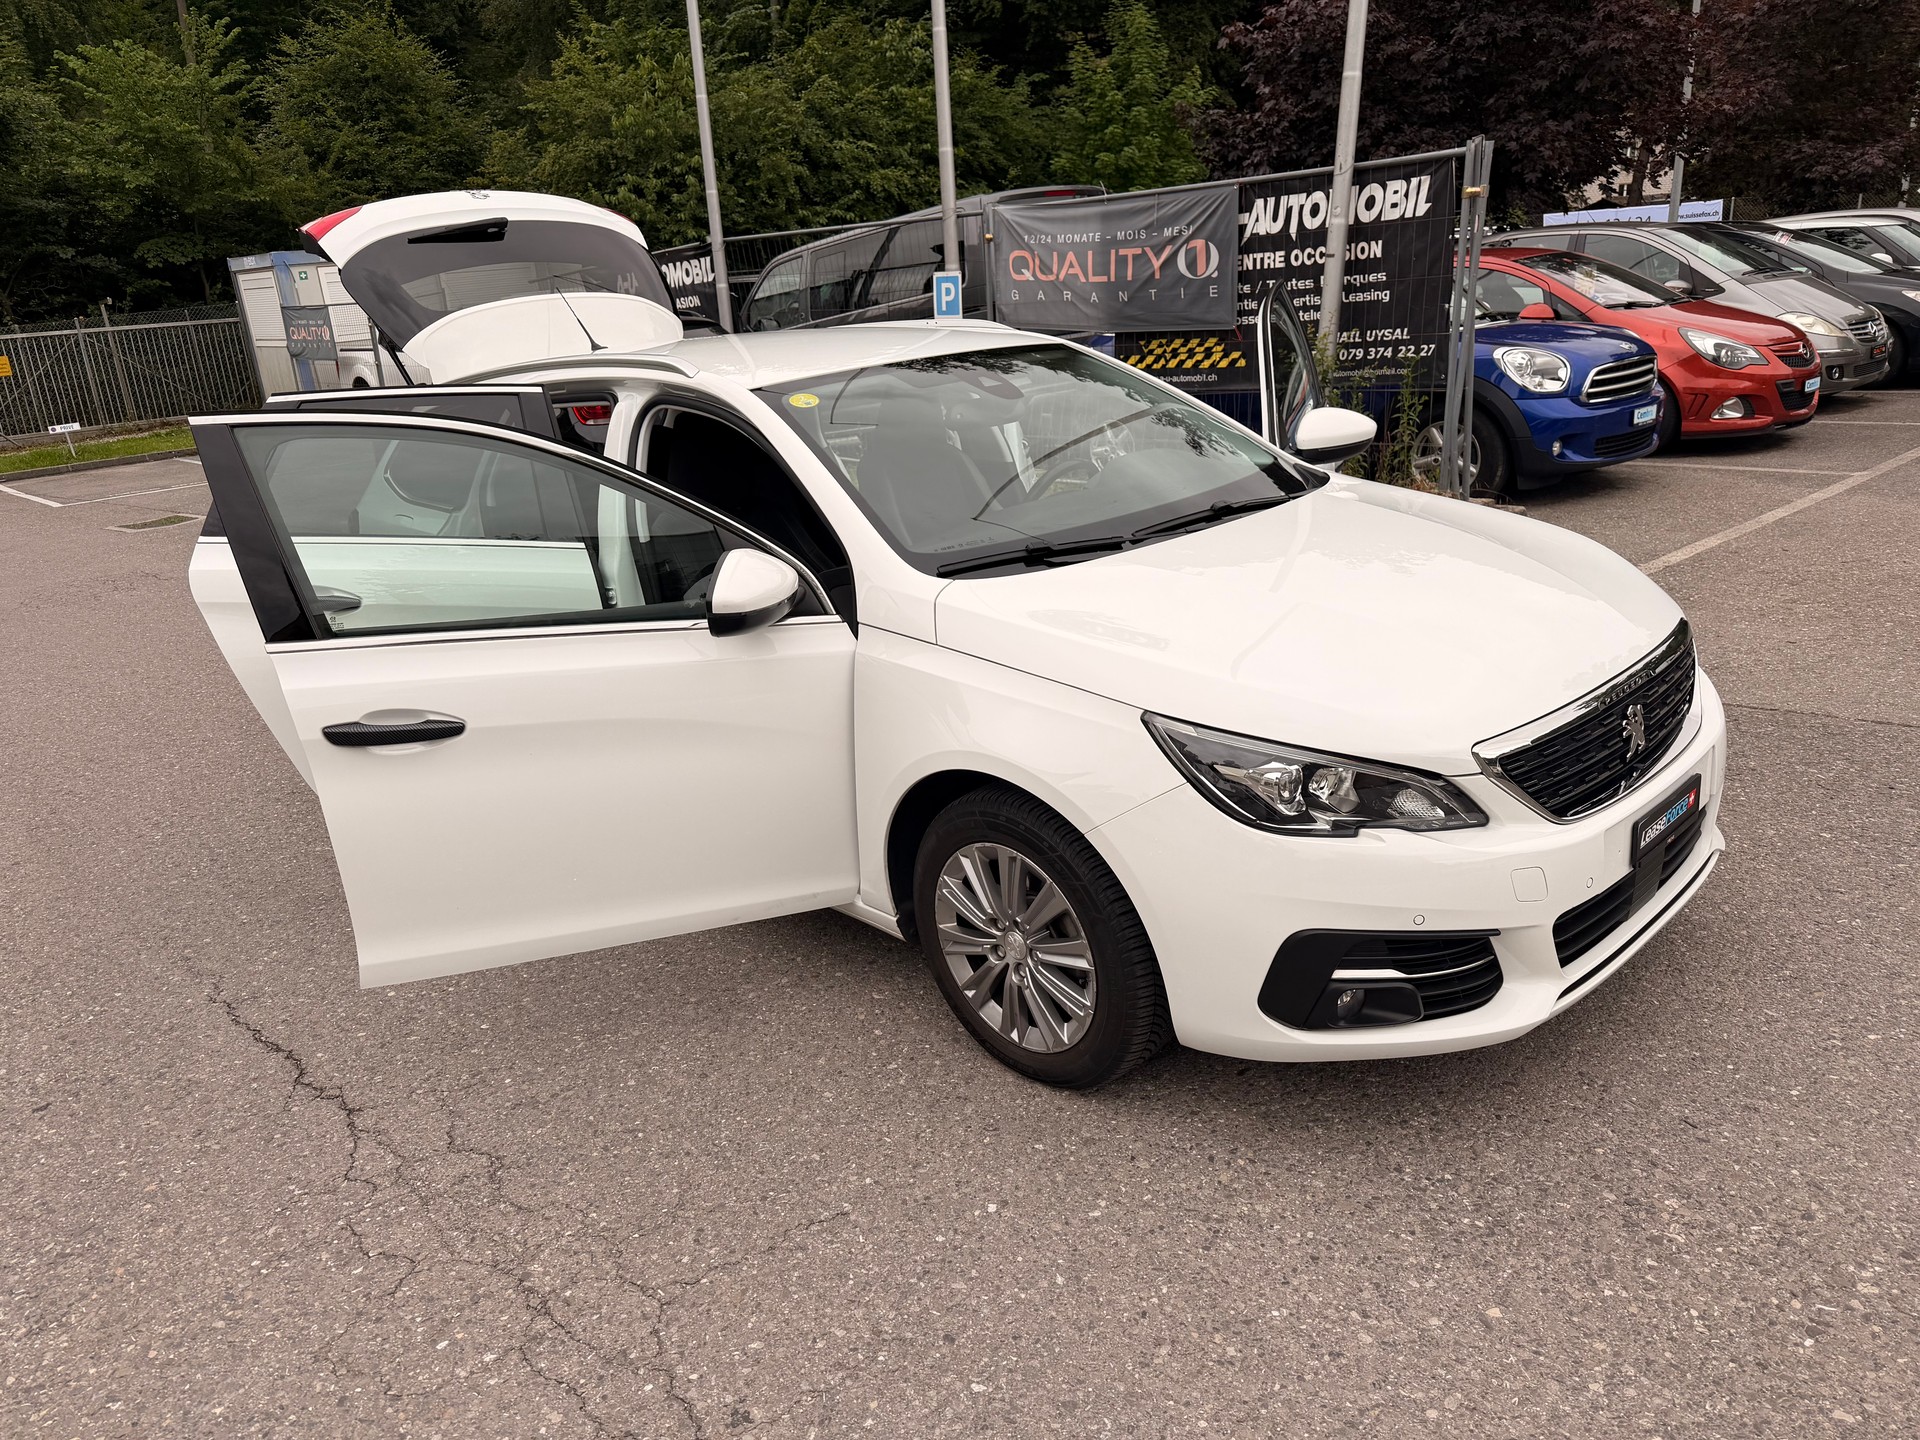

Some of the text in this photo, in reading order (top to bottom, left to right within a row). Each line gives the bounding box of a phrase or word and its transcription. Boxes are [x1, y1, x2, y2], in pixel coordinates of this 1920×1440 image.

[1024, 233, 1052, 244] 12/24
[1057, 232, 1101, 243] MONATE
[1117, 229, 1147, 240] MOIS
[1164, 224, 1194, 236] MESI
[1290, 239, 1383, 267] OCCSION
[1009, 244, 1173, 283] QUALITY
[676, 296, 701, 309] ASION
[941, 282, 956, 312] P
[1011, 285, 1219, 303] GARANTIE
[1342, 288, 1390, 303] Leasing
[290, 326, 322, 340] QUALITY
[1366, 327, 1411, 342] UYSAL
[1339, 344, 1436, 361] 079 374 22 27
